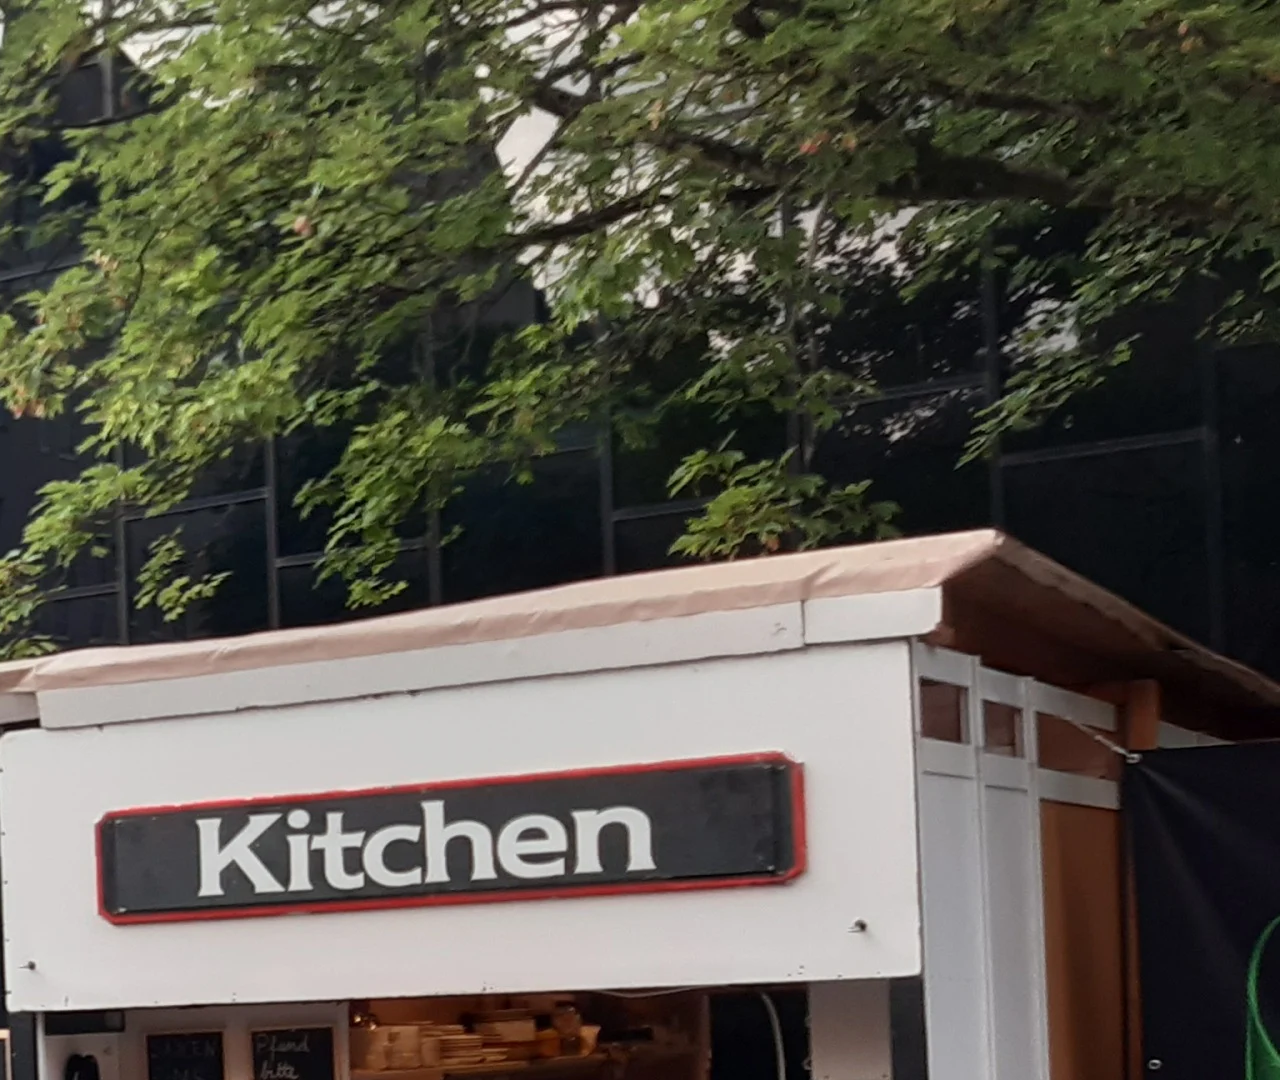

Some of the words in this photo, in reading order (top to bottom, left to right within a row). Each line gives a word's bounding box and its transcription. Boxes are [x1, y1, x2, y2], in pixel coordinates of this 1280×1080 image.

[196, 800, 657, 898] Kitchen
[256, 1034, 311, 1062] Pfand
[260, 1060, 300, 1080] bitte
